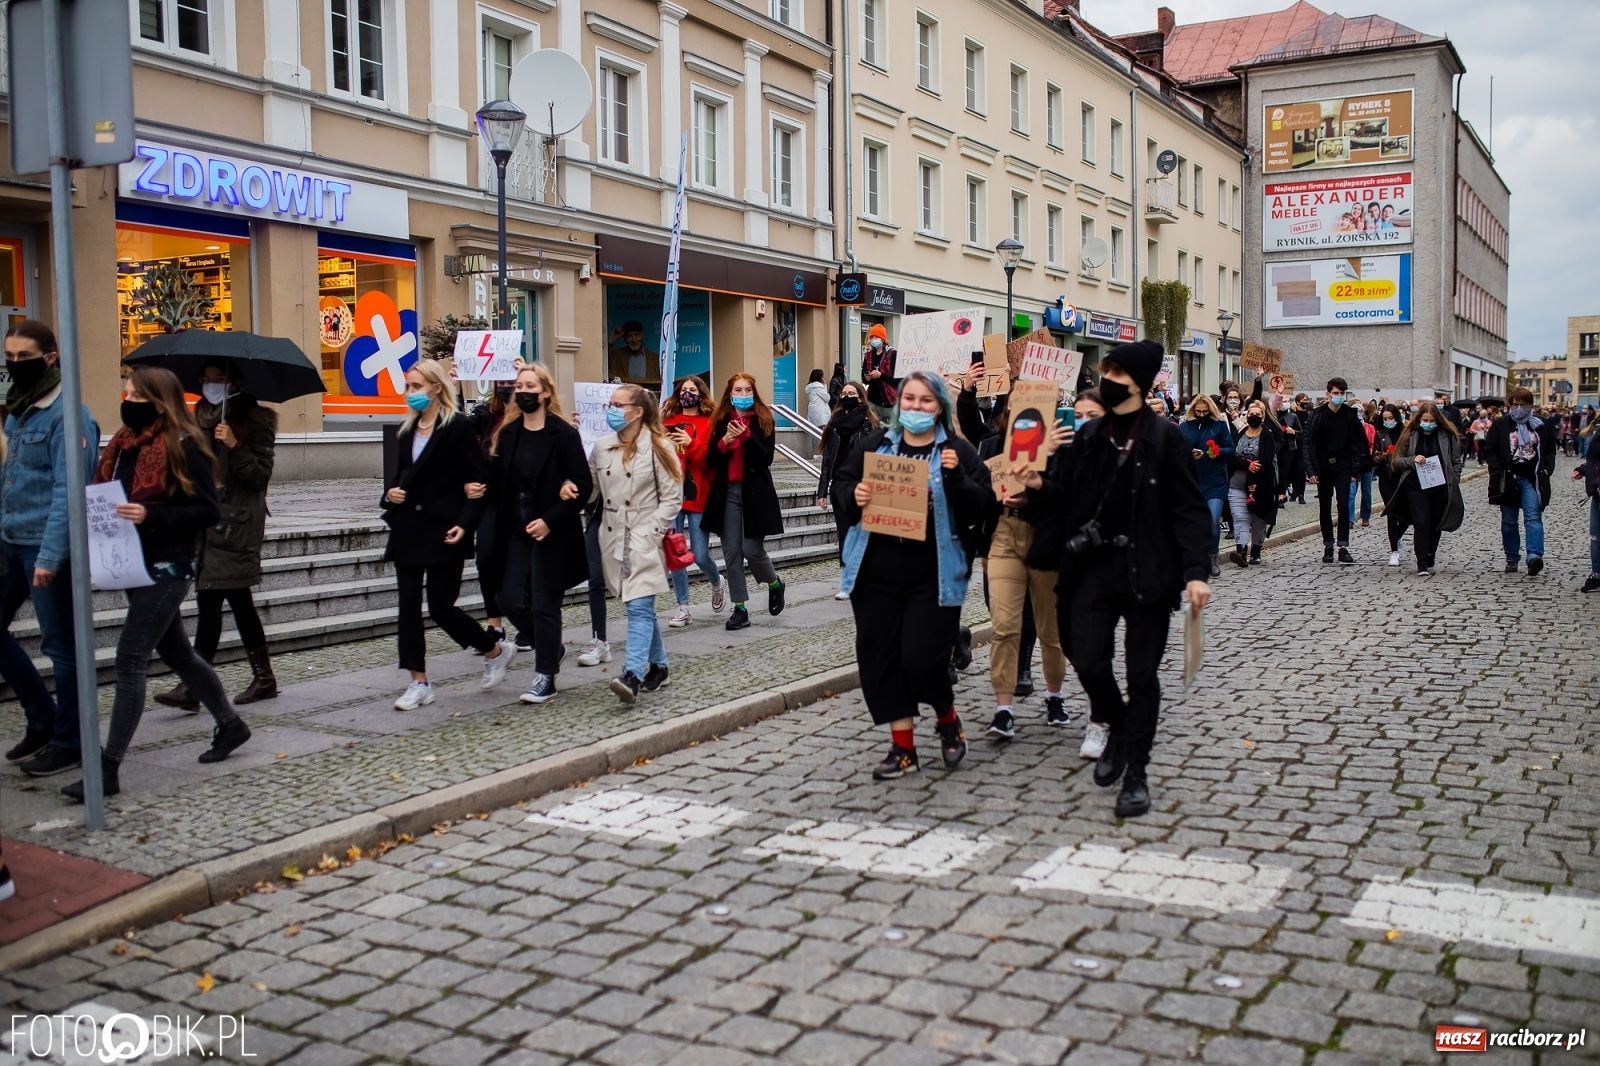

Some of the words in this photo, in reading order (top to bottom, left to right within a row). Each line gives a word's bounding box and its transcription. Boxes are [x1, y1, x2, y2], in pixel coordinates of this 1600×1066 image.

[1348, 100, 1382, 111] RYNEK
[1384, 99, 1391, 107] 8
[136, 145, 351, 222] ZDROWIT
[1274, 185, 1307, 193] Najlepsze
[1308, 182, 1326, 191] firmy
[1335, 177, 1375, 188] najlepszych
[1376, 176, 1402, 184] cenach
[1272, 186, 1405, 208] ALEXANDER
[1272, 207, 1318, 220] MEBLE
[1276, 236, 1319, 247] RYBNIK,
[1321, 236, 1333, 244] ul.
[1336, 232, 1380, 243] ŻORSKA
[1384, 231, 1400, 240] 192
[682, 291, 697, 299] bez
[842, 283, 859, 294] nest
[1336, 285, 1365, 298] 22,98
[871, 289, 894, 306] Juliette
[680, 301, 704, 310] domu
[1335, 309, 1394, 319] castorama
[1091, 321, 1114, 334] MATERACE
[681, 342, 702, 353] min
[1028, 344, 1073, 365] PIEKŁO
[1023, 361, 1061, 381] KOBIET
[877, 459, 916, 474] POLAND
[899, 485, 918, 497] PIS
